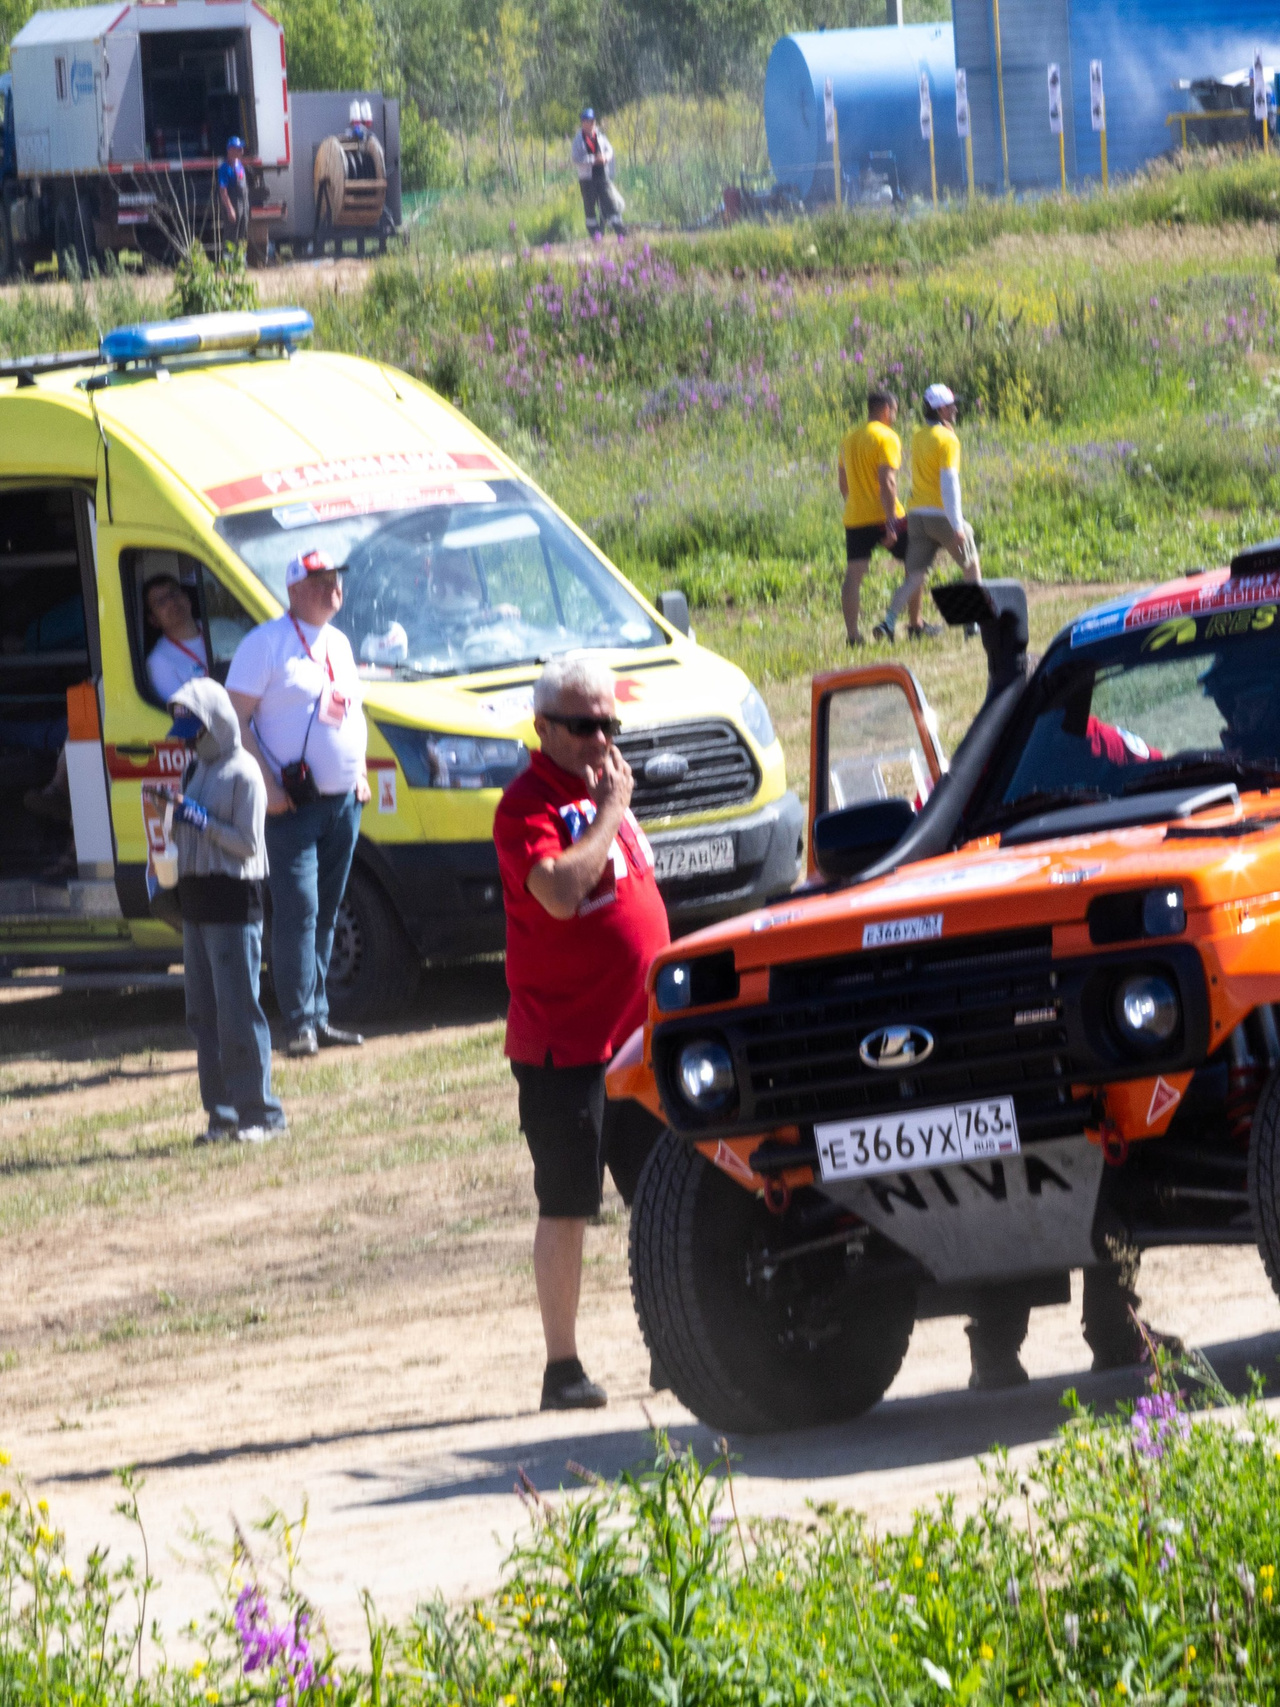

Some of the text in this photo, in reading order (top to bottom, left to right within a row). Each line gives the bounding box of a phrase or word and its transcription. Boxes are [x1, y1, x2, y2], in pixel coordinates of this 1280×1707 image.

[1131, 599, 1183, 627] RUSSIA
[158, 749, 198, 771] ПОМ
[958, 1102, 1004, 1139] 763
[973, 1140, 996, 1154] RUS
[865, 1155, 1073, 1215] NIVA
